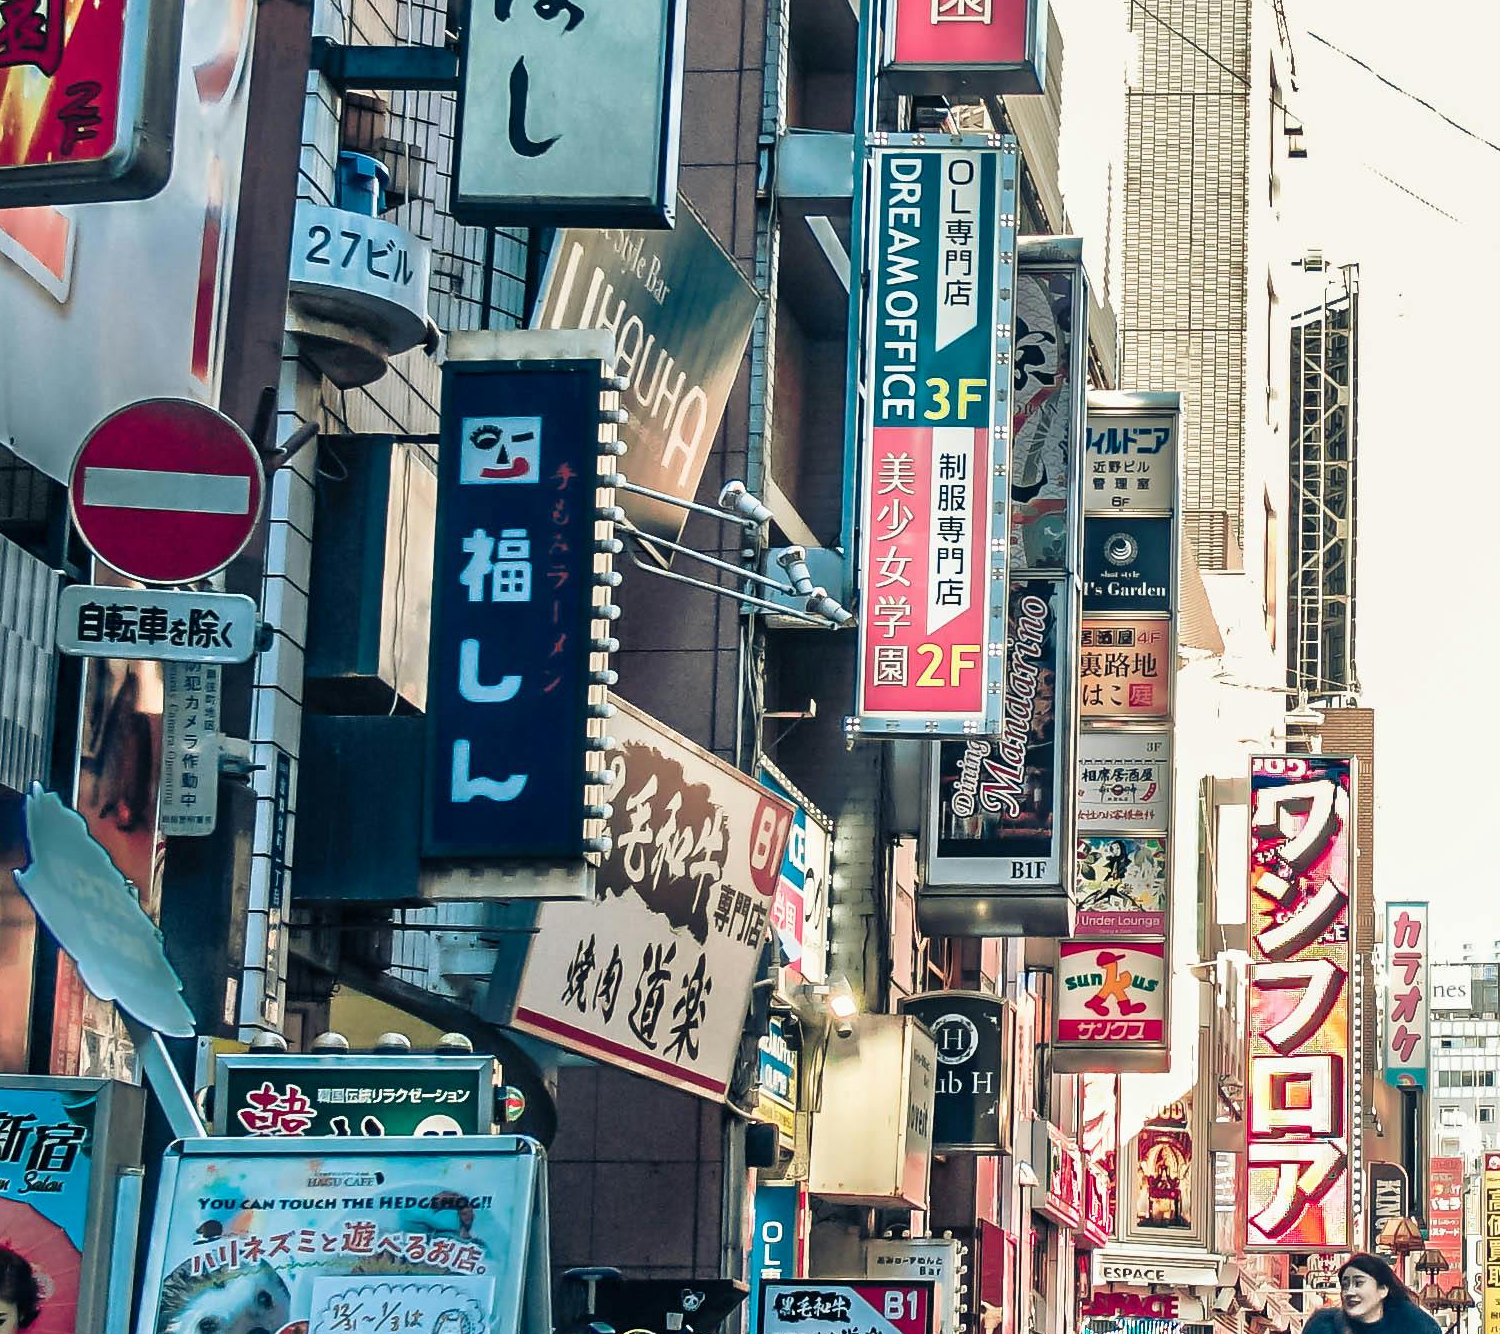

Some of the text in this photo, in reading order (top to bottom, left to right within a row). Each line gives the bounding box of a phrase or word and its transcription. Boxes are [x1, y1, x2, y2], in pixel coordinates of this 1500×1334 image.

[942, 159, 974, 308] OL専門店
[304, 222, 414, 288] 27ビル
[882, 157, 923, 422] DREAM OFFICE
[923, 378, 988, 421] 3F
[1093, 460, 1150, 473] 近野ビル
[1093, 478, 1150, 490] 管理室
[1111, 497, 1131, 507] 6F
[934, 452, 967, 608] 制服専門店
[872, 452, 917, 687] 美少女学園
[1108, 582, 1166, 596] Garden
[76, 602, 234, 650] 自転車を除く
[1137, 632, 1164, 645] 4F
[448, 527, 534, 805] 福しん
[916, 643, 981, 687] 2F
[1080, 652, 1158, 678] 裏路地
[979, 594, 1047, 818] Mandarino
[1082, 684, 1123, 707] はこ
[1146, 742, 1162, 752] 3F
[951, 739, 991, 817] Dining
[752, 804, 788, 871] B1
[1010, 860, 1047, 880] B1F
[713, 884, 769, 950] 専門店
[1081, 916, 1115, 927] Under
[560, 932, 712, 1063] 焼肉 道楽
[1391, 911, 1422, 1063] カラオケ
[1078, 1021, 1146, 1040] サンクス
[317, 1087, 470, 1104] 韓国伝統リラクゼーション
[18, 1171, 64, 1193] Salon
[198, 1197, 237, 1210] YOU
[240, 1198, 274, 1210] CAN
[278, 1198, 337, 1210] TOUCH
[341, 1197, 374, 1210] THE
[191, 1221, 487, 1276] ハリネズミと遊べるお店。
[919, 1267, 942, 1275] Bar
[1104, 1267, 1165, 1281] ESPACE
[779, 1290, 918, 1321] 黒毛和牛 B1
